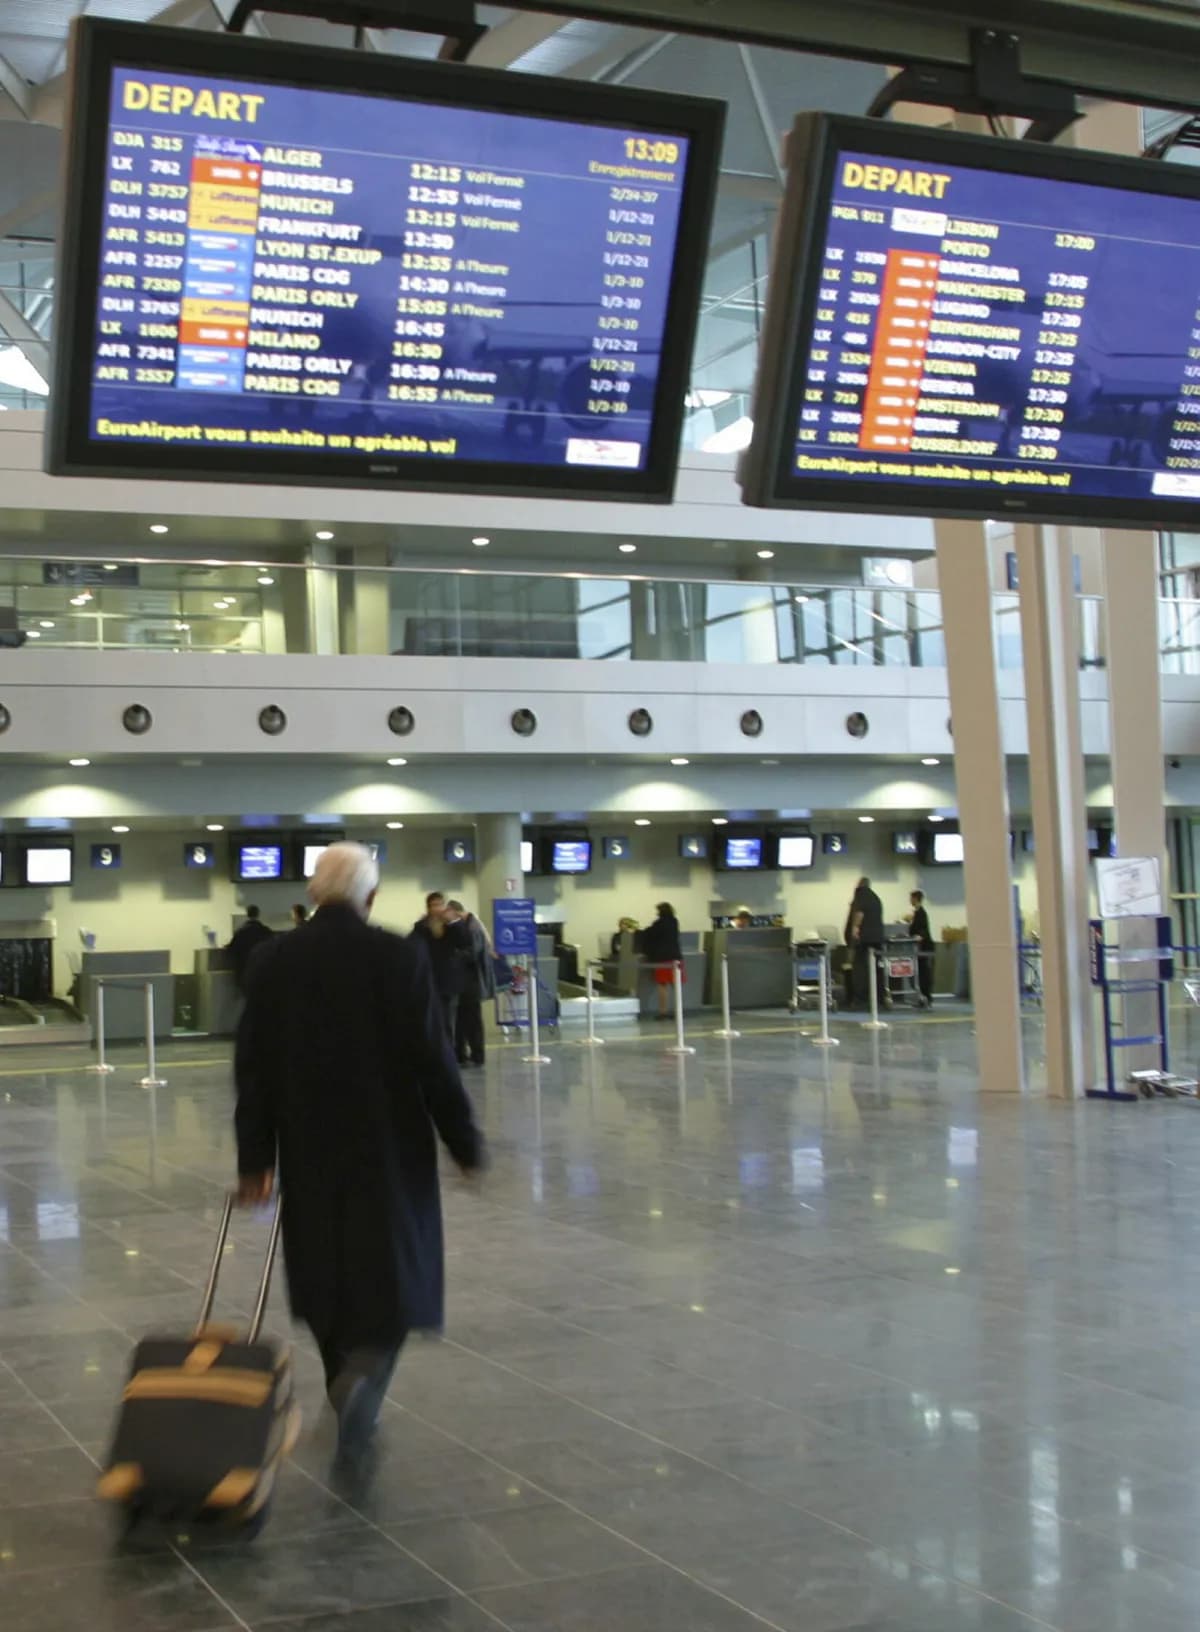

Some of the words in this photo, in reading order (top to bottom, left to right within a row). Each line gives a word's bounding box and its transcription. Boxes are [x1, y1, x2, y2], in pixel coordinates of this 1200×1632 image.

[123, 80, 264, 122] DEPART
[263, 147, 322, 168] ALGER
[410, 164, 461, 183] 12:15
[624, 138, 678, 164] 13:09
[111, 156, 133, 171] LX
[262, 169, 354, 194] BRUSSELS
[588, 160, 675, 182] Enregistrement
[842, 161, 951, 199] DEPART
[110, 180, 142, 195] DLH
[260, 193, 334, 216] MUNICH
[406, 208, 456, 228] 13:15
[108, 203, 141, 219] DLH
[258, 216, 362, 240] FRANKFURT
[946, 219, 999, 239] LISBON
[106, 227, 138, 242] AFR
[256, 240, 304, 259] LYON
[307, 244, 382, 265] ST.EXUP
[941, 239, 991, 258] PORTO
[104, 250, 137, 265] AFR
[254, 262, 310, 282] PARIS
[312, 268, 350, 285] CDG
[939, 258, 1020, 282] BARCELONA
[103, 274, 135, 289] AFR
[252, 284, 308, 304] PARIS
[310, 290, 358, 308] ORLY
[398, 297, 448, 315] 15:05
[936, 280, 1026, 303] MANCHESTER
[101, 297, 134, 312] DLH
[251, 308, 324, 328] MUNICH
[395, 319, 445, 338] 16:45
[100, 321, 121, 335] LX
[248, 330, 320, 350] MILANO
[925, 339, 1021, 361] LONDON-CITY
[98, 343, 130, 358] AFR
[246, 352, 302, 371] PARIS
[304, 357, 352, 374] ORLY
[923, 358, 977, 377] VIENNA
[97, 366, 129, 381] AFR
[245, 375, 300, 393] PARIS
[302, 379, 340, 395] CDG
[916, 397, 1000, 417] AMSTERDAM
[96, 418, 202, 441] EuroAirport
[204, 427, 247, 442] vous
[251, 428, 325, 447] souhaite
[328, 434, 351, 448] un
[353, 433, 427, 452] agréable
[430, 437, 456, 454] vol
[797, 455, 878, 475] EuroAirport
[879, 463, 912, 476] vous
[913, 463, 971, 480] souhaite
[1049, 472, 1071, 487] vol
[101, 847, 113, 866] 9
[193, 846, 207, 864] 8
[453, 842, 465, 859] 6
